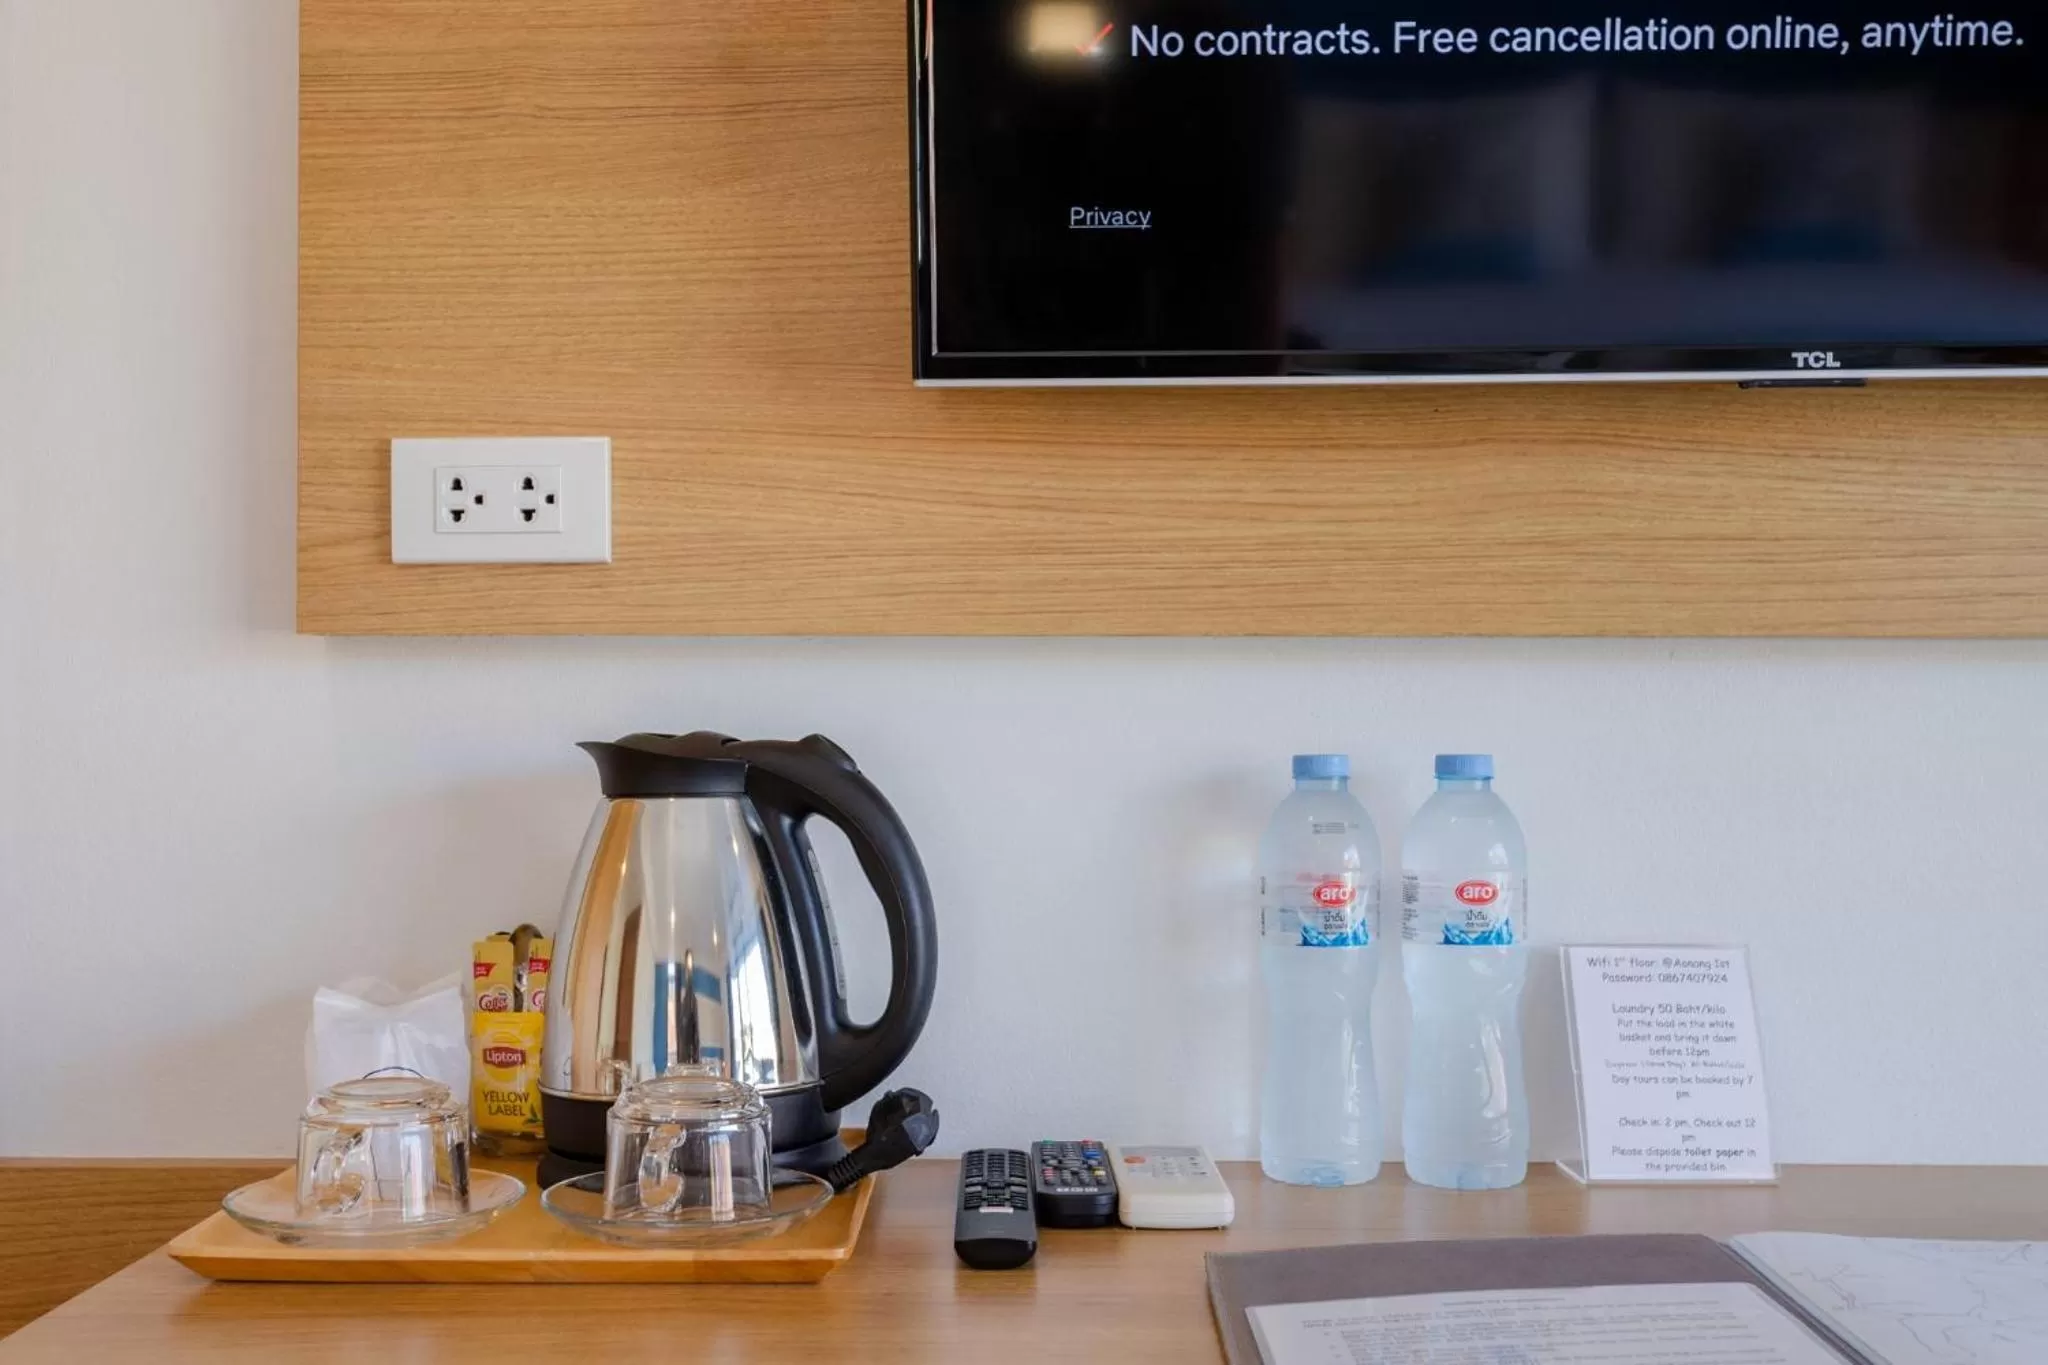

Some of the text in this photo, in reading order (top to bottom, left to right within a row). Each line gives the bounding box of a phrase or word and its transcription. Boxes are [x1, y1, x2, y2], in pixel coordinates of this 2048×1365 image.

[1131, 14, 2024, 57] No contracts. Free cancellation online, anytime.
[1070, 206, 1152, 230] Privacy
[1791, 351, 1841, 368] TCL
[1320, 887, 1349, 901] aro
[1463, 886, 1493, 899] aro
[1612, 1003, 1655, 1016] Laundry
[486, 1050, 522, 1064] Lipton
[1695, 1075, 1730, 1085] booked
[483, 1091, 530, 1104] YELLOW
[488, 1104, 526, 1116] LABEL
[1618, 1117, 1648, 1128] Check
[1693, 1117, 1724, 1128] Check
[1612, 1146, 1643, 1157] Please
[1684, 1147, 1712, 1157] toilet
[1715, 1148, 1744, 1160] paper
